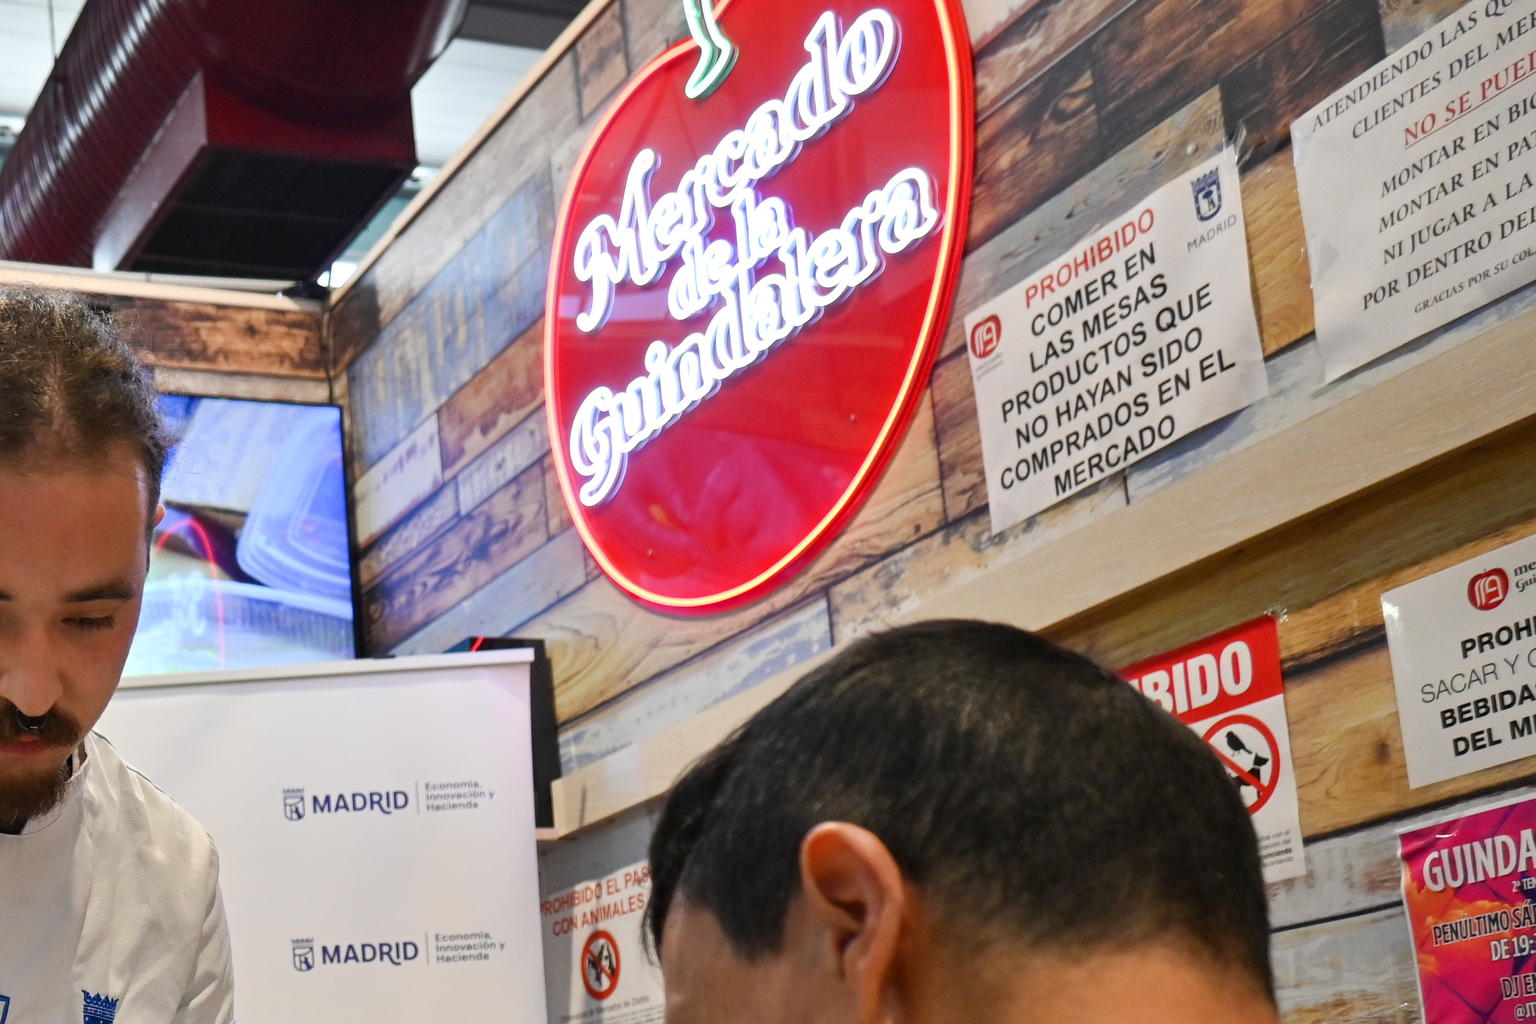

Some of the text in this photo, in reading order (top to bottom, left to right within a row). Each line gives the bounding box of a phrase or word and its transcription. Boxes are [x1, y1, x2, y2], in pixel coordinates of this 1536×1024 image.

[1312, 41, 1433, 133] ATENDIENDO
[1440, 10, 1477, 47] LAS
[1352, 71, 1442, 139] CLIENTES
[1448, 43, 1489, 80] DEL
[1403, 112, 1436, 146] NO
[1445, 91, 1472, 124] SE
[573, 8, 896, 332] Mercado
[1381, 136, 1465, 198] MONTAR
[1473, 113, 1500, 145] EN
[1378, 172, 1464, 234] MONTAR
[1470, 151, 1500, 182] EN
[1383, 173, 1534, 266] NI JUGAR A LA
[667, 188, 792, 321] de la
[1024, 208, 1155, 309] PROHIBIDO
[1187, 214, 1238, 253] MADRID
[1030, 242, 1156, 337] COMER EN
[1362, 283, 1402, 311] POR
[1406, 231, 1492, 289] DENTRO
[1414, 283, 1464, 314] GRACIAS
[1468, 268, 1490, 289] POR
[1494, 259, 1508, 276] SU
[569, 167, 944, 507] Guindalera
[1001, 282, 1213, 424] PRODUCTOS QUE
[1029, 329, 1075, 373] LAS
[1082, 272, 1168, 342] MESAS
[1000, 348, 1236, 491] COMPRADOS EN EL
[1015, 326, 1203, 449] NO HAYAN SIDO
[1054, 415, 1175, 497] MERCADO
[1128, 640, 1253, 715] BIDO
[1421, 662, 1498, 703] SACAR
[1504, 653, 1519, 675] Y
[1440, 683, 1536, 729] BEBIDA
[1452, 728, 1502, 757] DEL
[313, 790, 409, 814] MADRID
[426, 790, 495, 800] Innovación y
[426, 800, 479, 811] Hacienda
[553, 893, 645, 937] CON ANIMALES
[606, 878, 621, 896] EL
[322, 941, 419, 965] MADRID
[436, 941, 506, 952] Innovación y
[436, 952, 490, 963] Hacienda
[1432, 913, 1510, 947] PENÚLTIMO
[1490, 939, 1510, 961] DE
[1501, 975, 1519, 1000] DJ
